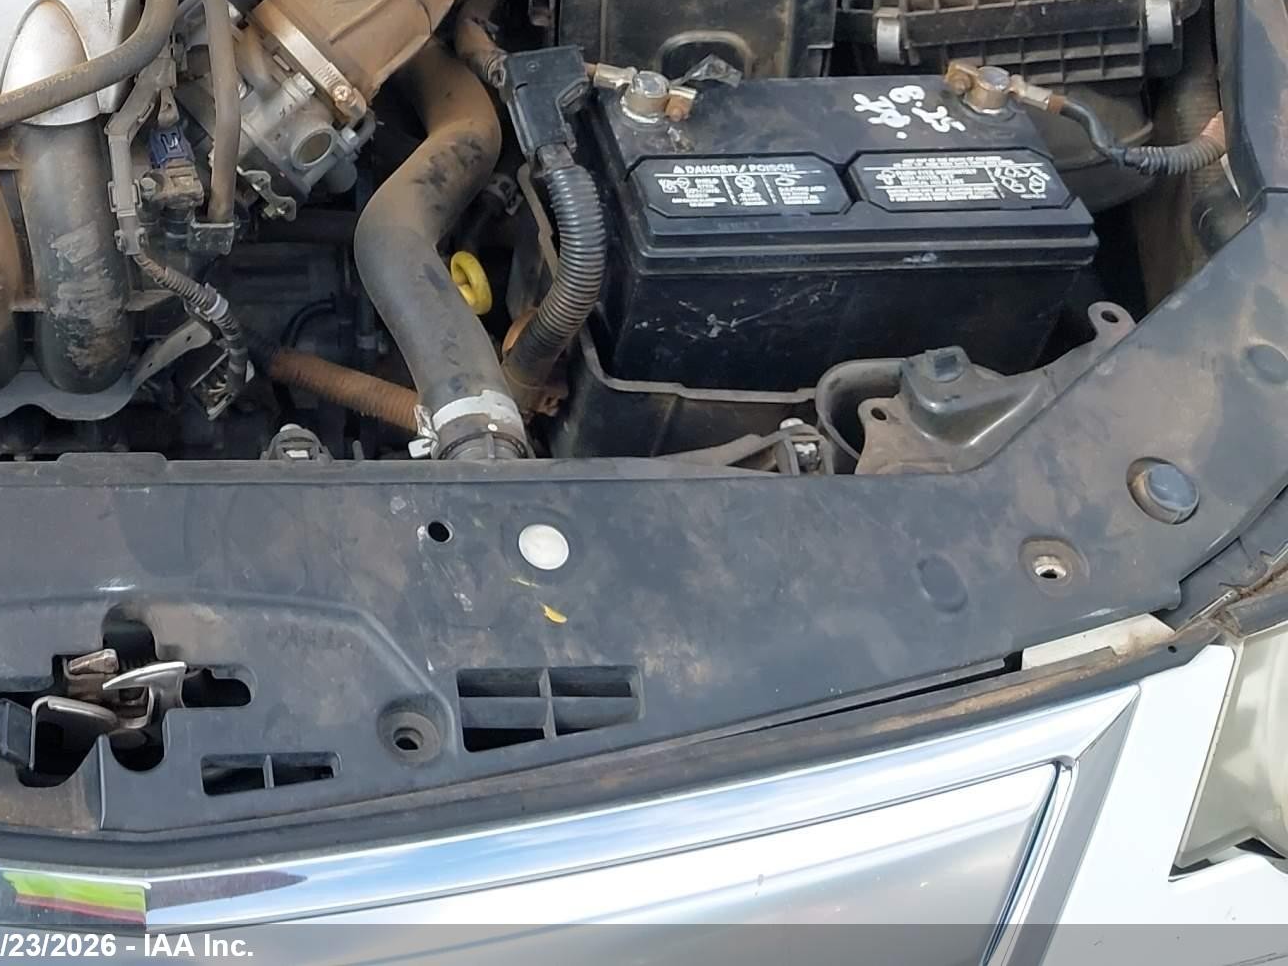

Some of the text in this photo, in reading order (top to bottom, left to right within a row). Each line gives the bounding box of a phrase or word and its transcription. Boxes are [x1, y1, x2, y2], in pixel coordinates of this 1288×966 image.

[684, 162, 796, 174] DANGER / POISON
